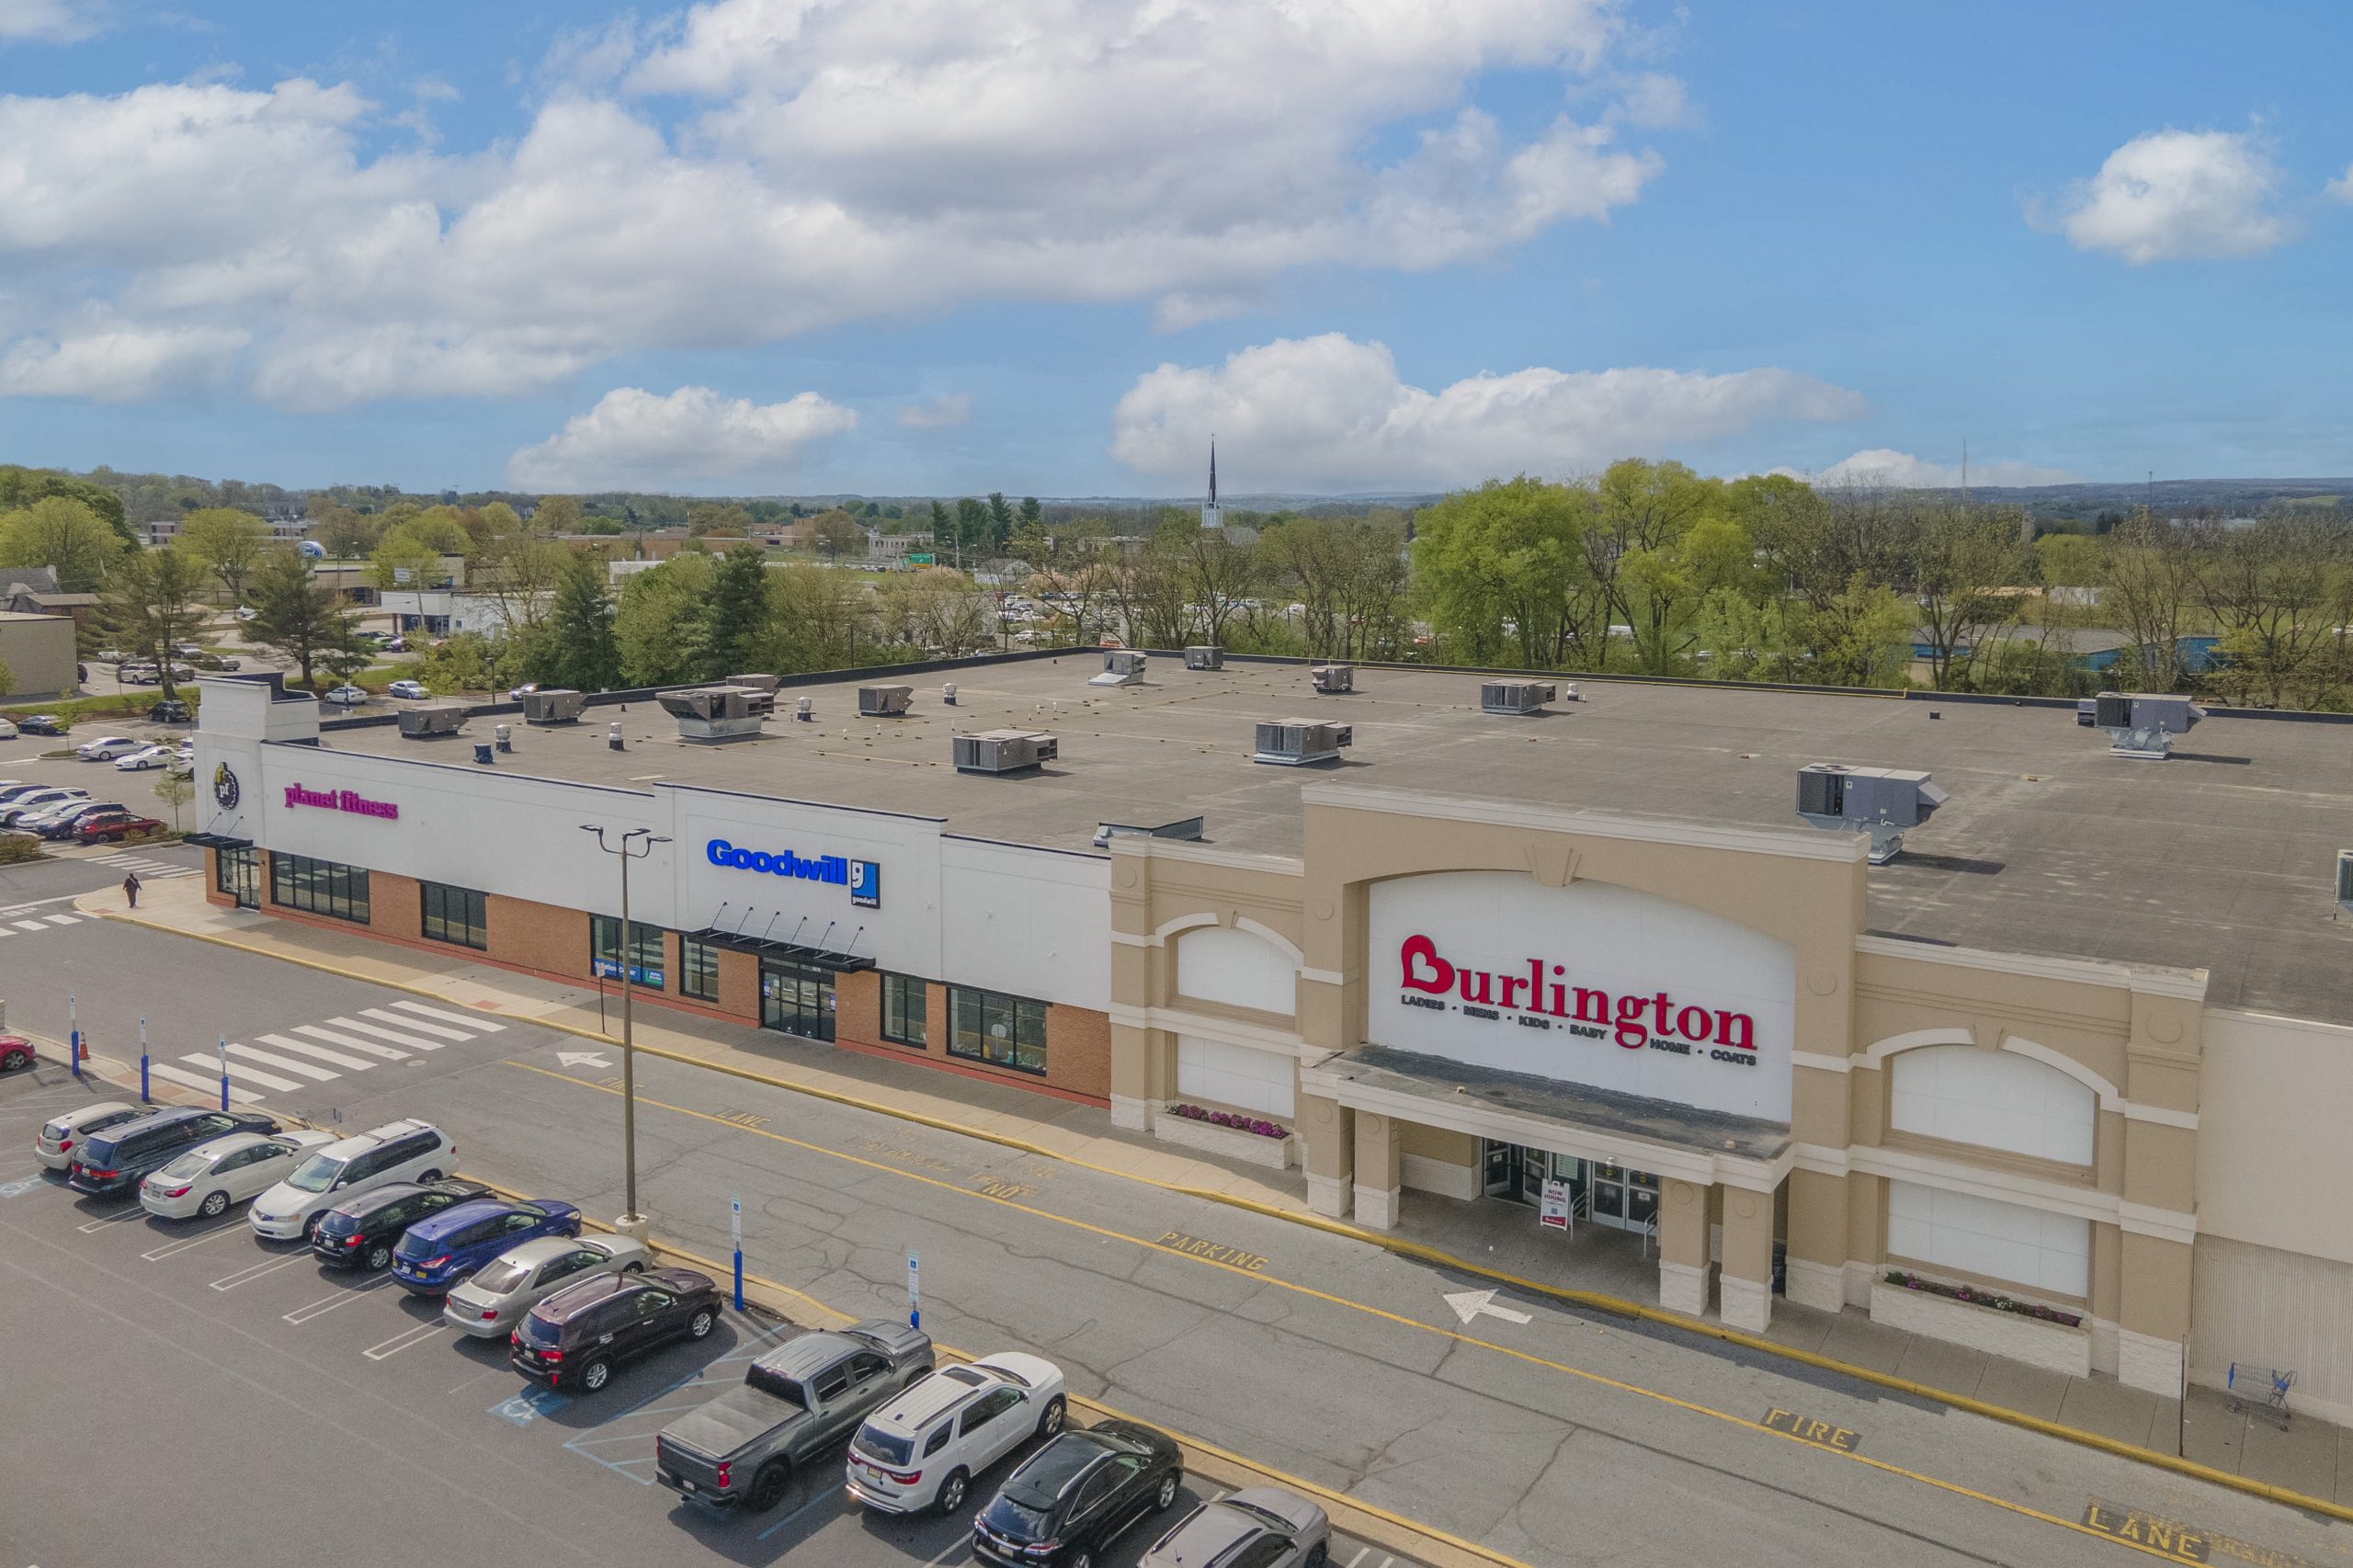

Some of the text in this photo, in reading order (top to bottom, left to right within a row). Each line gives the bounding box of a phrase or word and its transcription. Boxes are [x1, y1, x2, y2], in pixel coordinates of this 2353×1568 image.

[220, 782, 229, 798] pf
[284, 783, 398, 819] planet fitness
[707, 839, 847, 885] Goodwill
[1401, 934, 1758, 1050] Burlington
[1401, 994, 1757, 1066] LADIES MENS KIDS BABY HOME COATS
[715, 1108, 773, 1128] LANE
[983, 1182, 1020, 1199] NO
[1156, 1232, 1269, 1270] PARKING
[1765, 1408, 1854, 1449] FIRE
[2087, 1505, 2201, 1560] LANE
